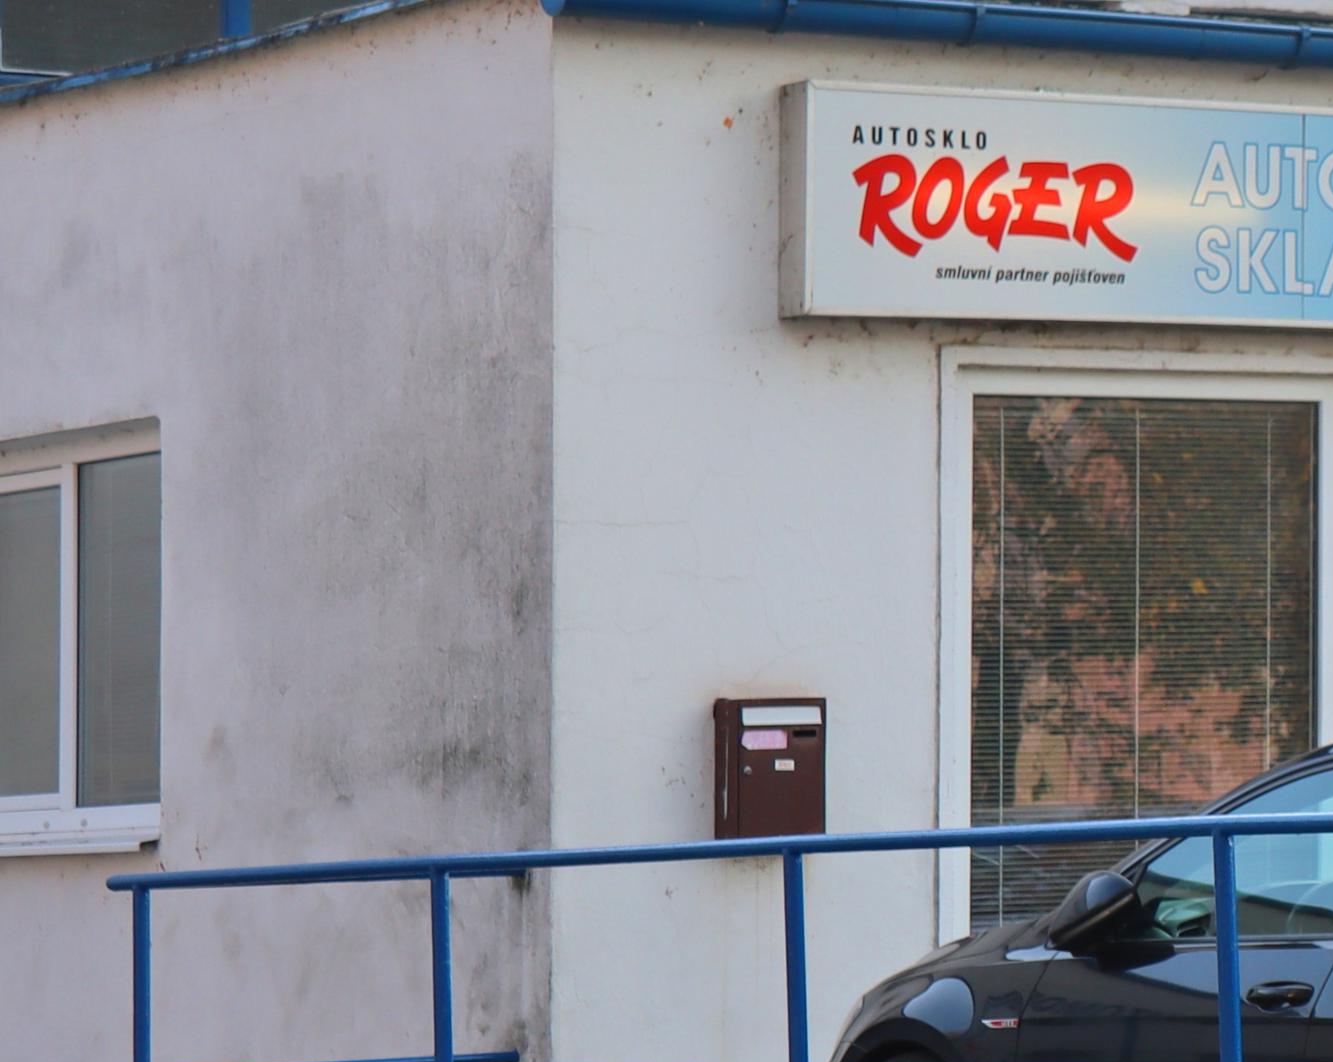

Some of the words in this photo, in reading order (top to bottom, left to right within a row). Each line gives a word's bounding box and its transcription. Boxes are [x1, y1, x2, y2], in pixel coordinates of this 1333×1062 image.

[852, 125, 988, 150] AUTOSKLO
[852, 154, 1138, 263] ROGER
[935, 265, 992, 281] smluvní
[995, 266, 1049, 284] partner
[1052, 268, 1125, 287] pojišťoven
